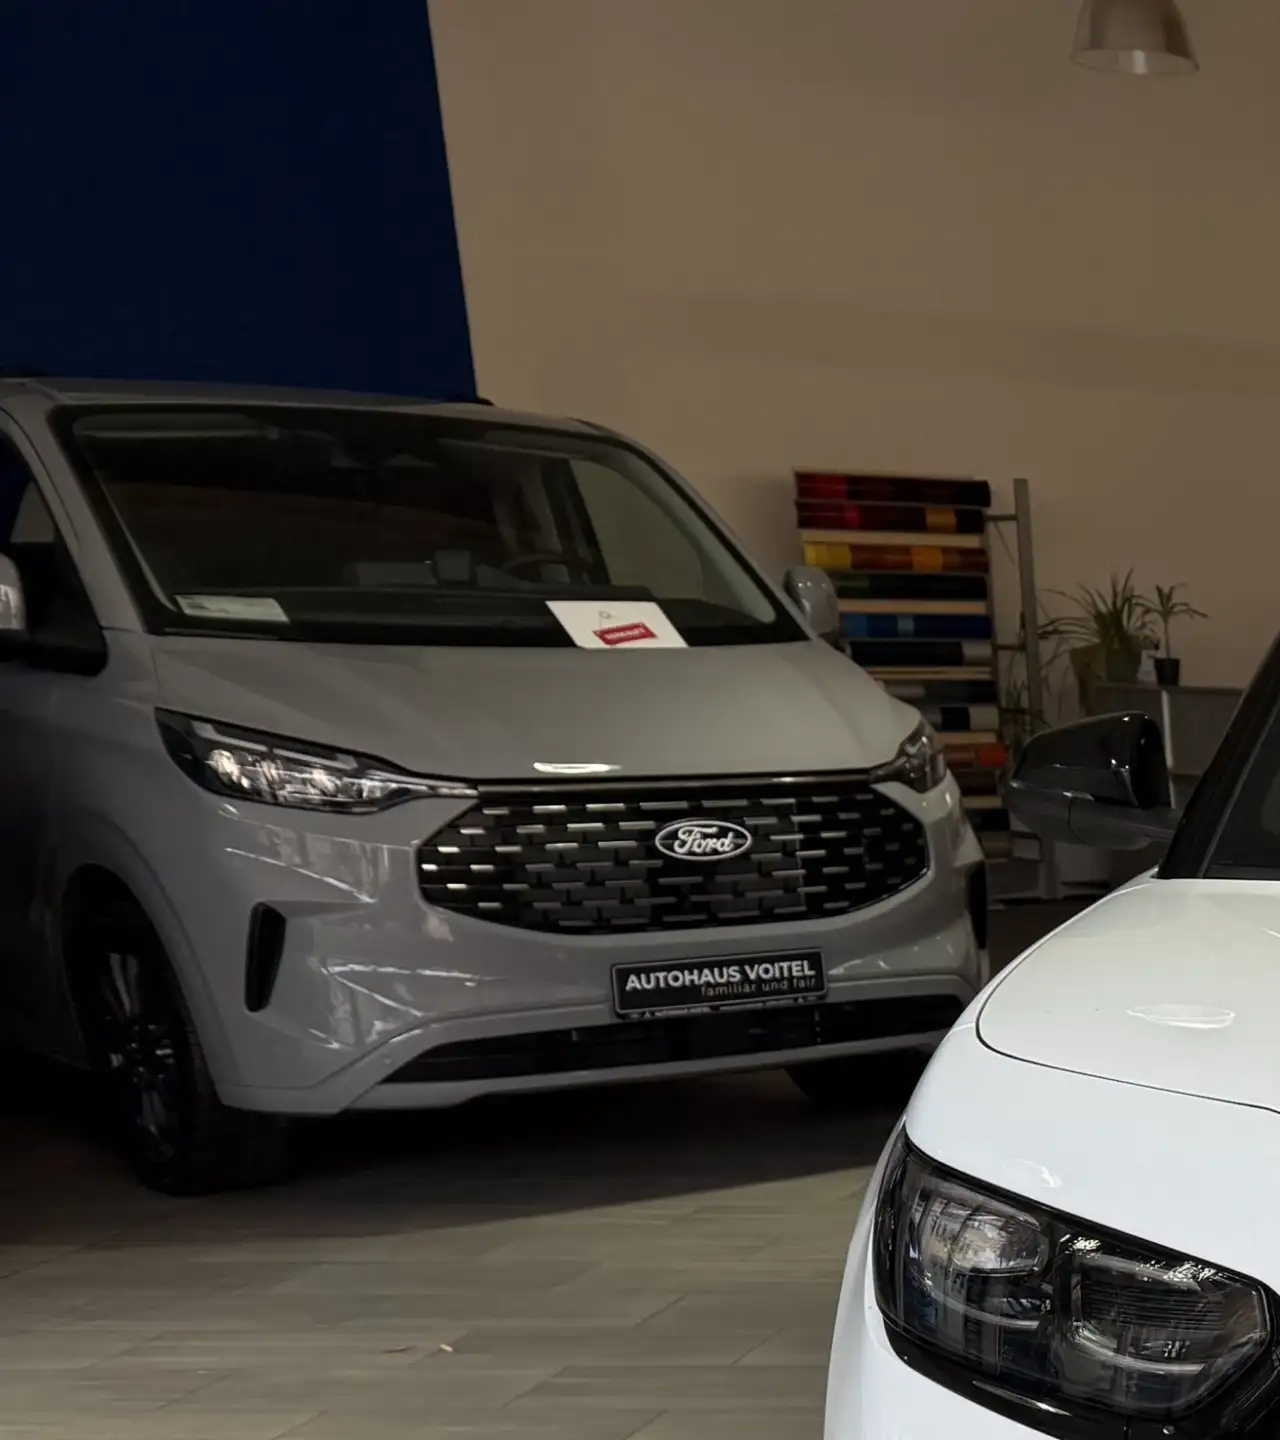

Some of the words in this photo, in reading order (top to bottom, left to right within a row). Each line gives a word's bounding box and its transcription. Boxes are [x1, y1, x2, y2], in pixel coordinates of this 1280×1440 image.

[673, 826, 735, 854] Ford
[625, 965, 741, 992] AUTOHAUS
[744, 960, 816, 981] VOITEL
[762, 979, 788, 992] und
[793, 976, 816, 989] fair
